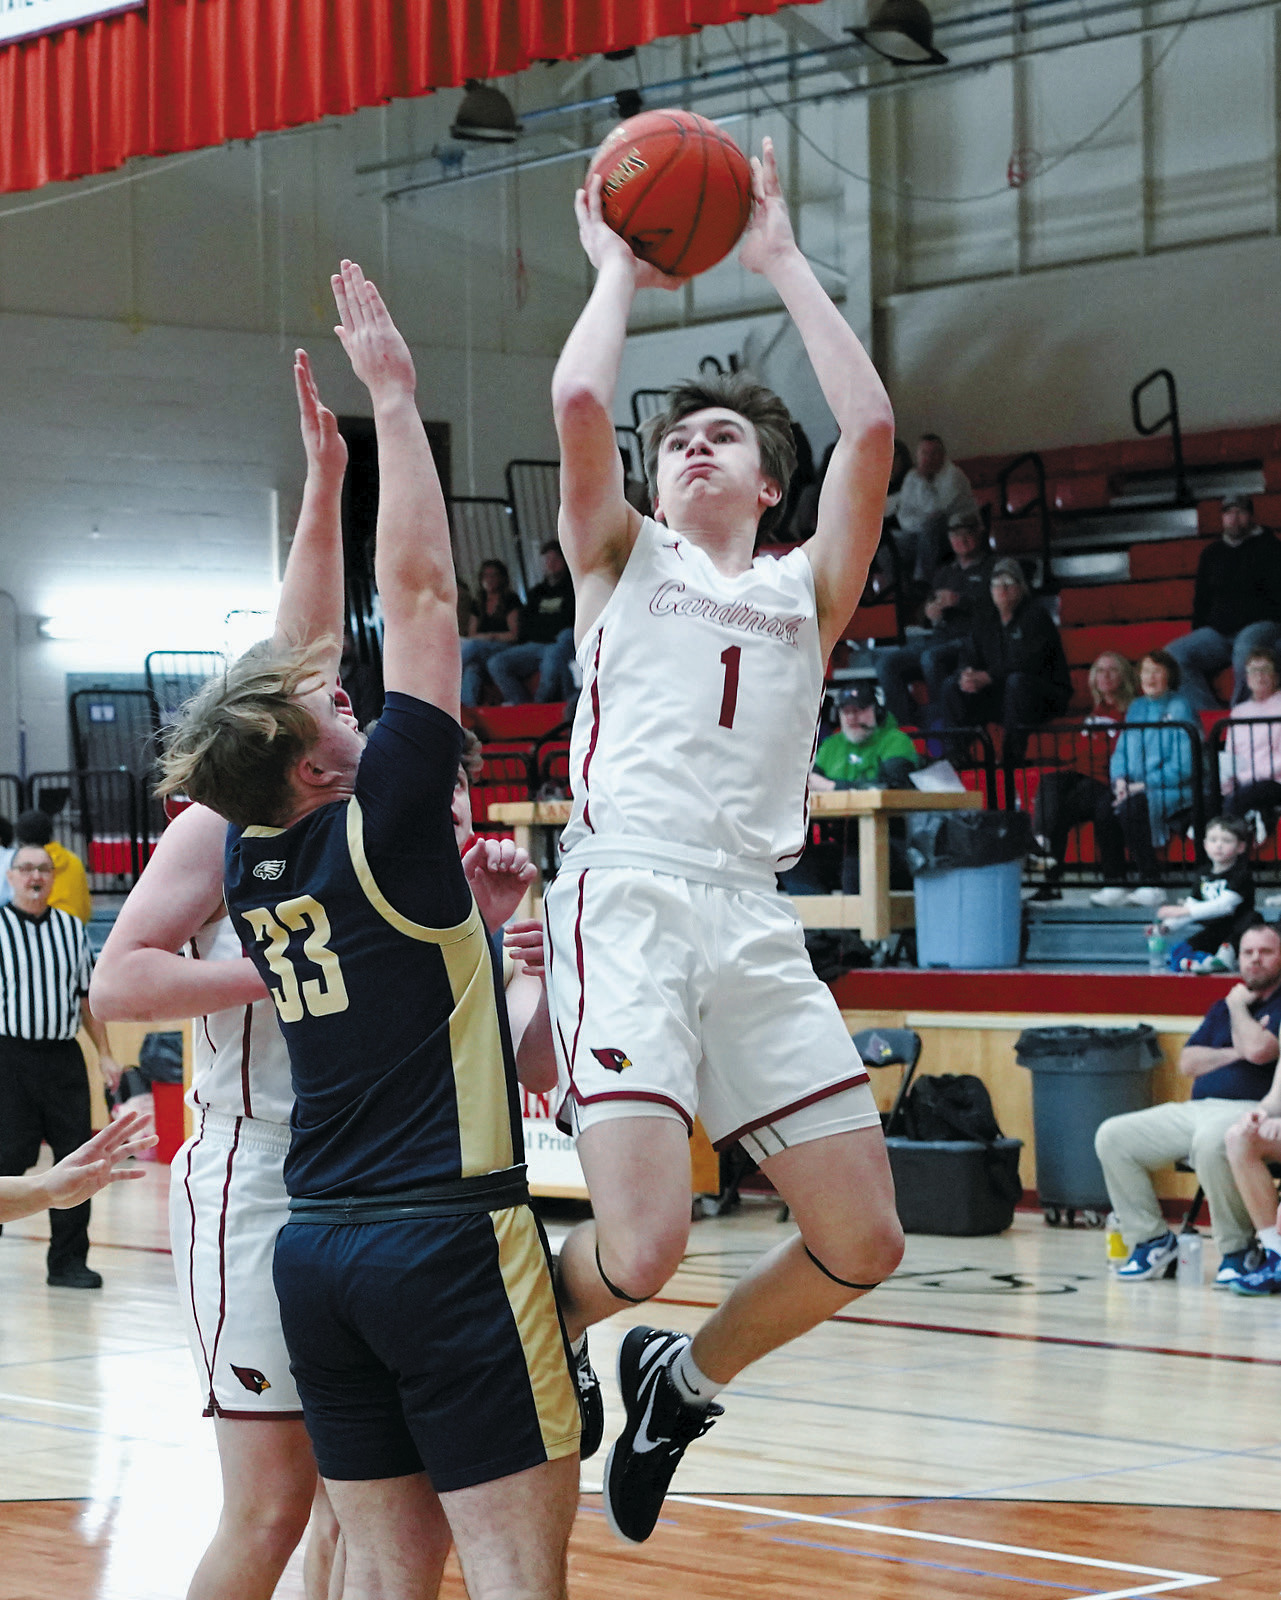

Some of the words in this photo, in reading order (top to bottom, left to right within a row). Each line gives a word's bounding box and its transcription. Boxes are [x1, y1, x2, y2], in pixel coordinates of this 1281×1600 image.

[718, 645, 742, 729] 1
[241, 894, 349, 1023] 33
[538, 1131, 577, 1151] Prid
